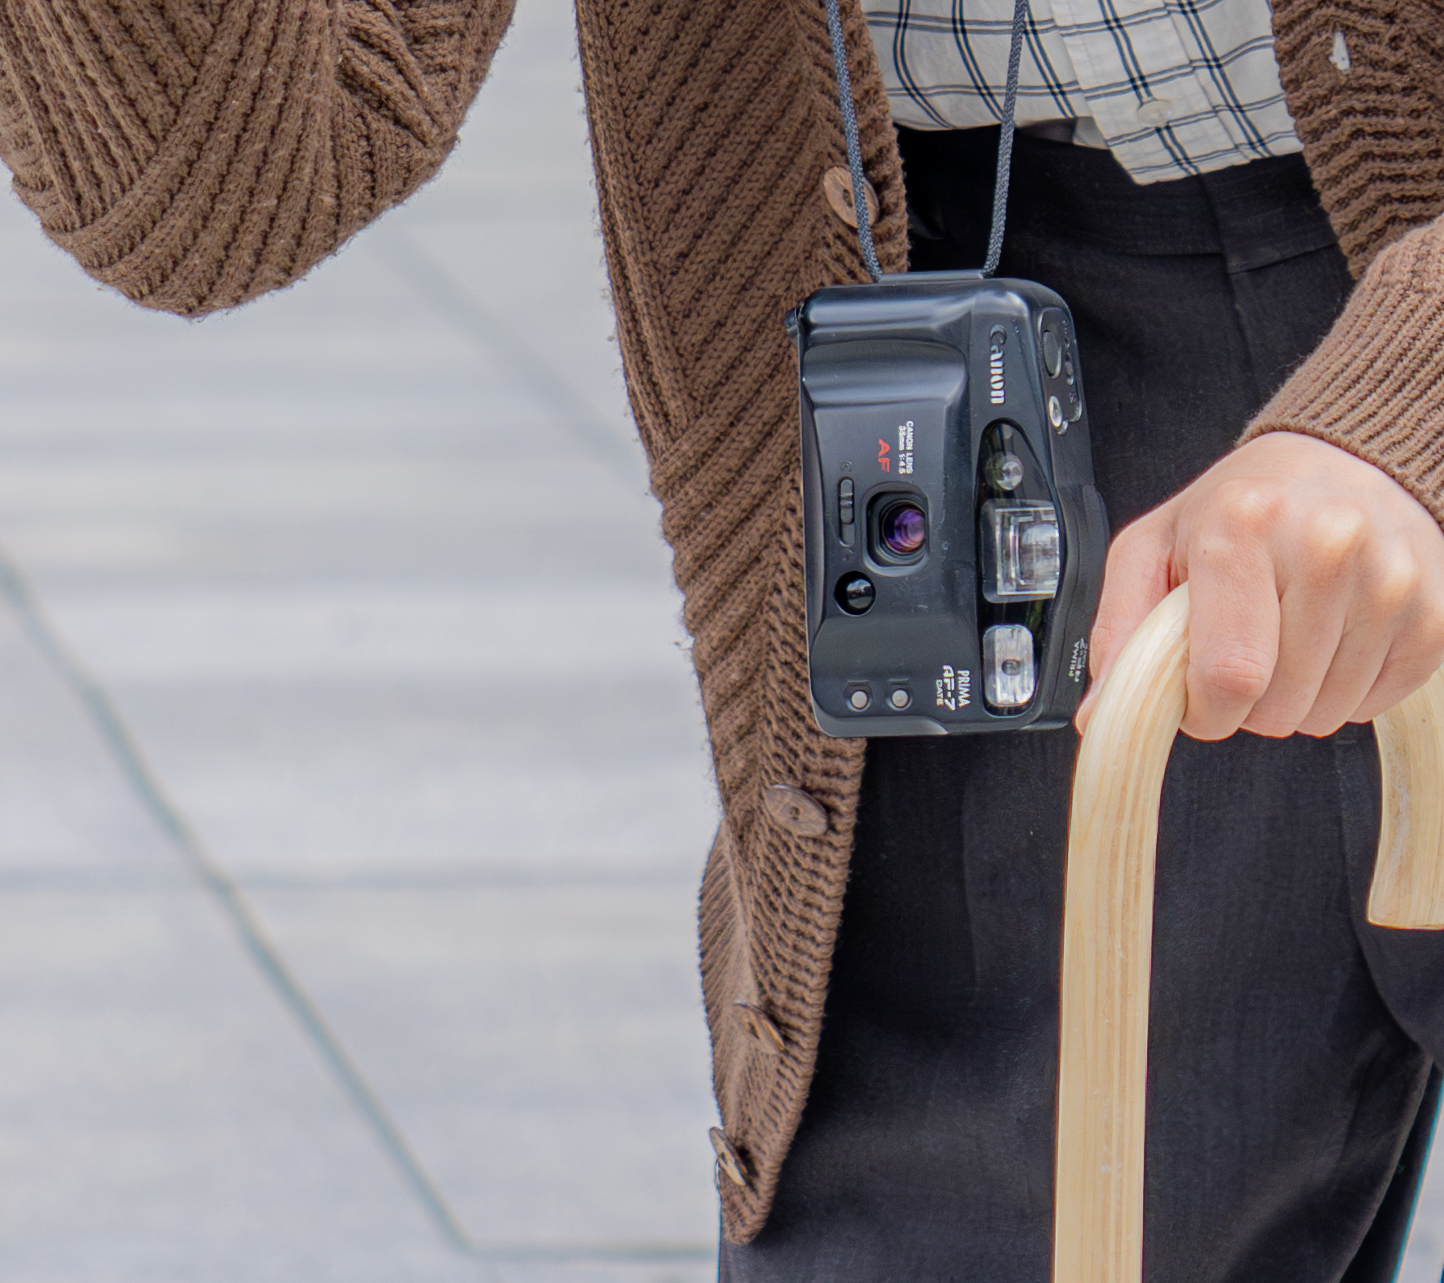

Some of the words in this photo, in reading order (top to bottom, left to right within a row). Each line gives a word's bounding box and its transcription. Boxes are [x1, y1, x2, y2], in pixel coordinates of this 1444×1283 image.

[990, 324, 1007, 404] Canon
[898, 425, 906, 451] 35mm
[906, 420, 914, 450] CANON
[877, 438, 891, 473] AF
[906, 452, 914, 475] LENS
[935, 679, 944, 706] DATE
[942, 665, 956, 711] AF-7
[957, 670, 970, 708] PRIMA
